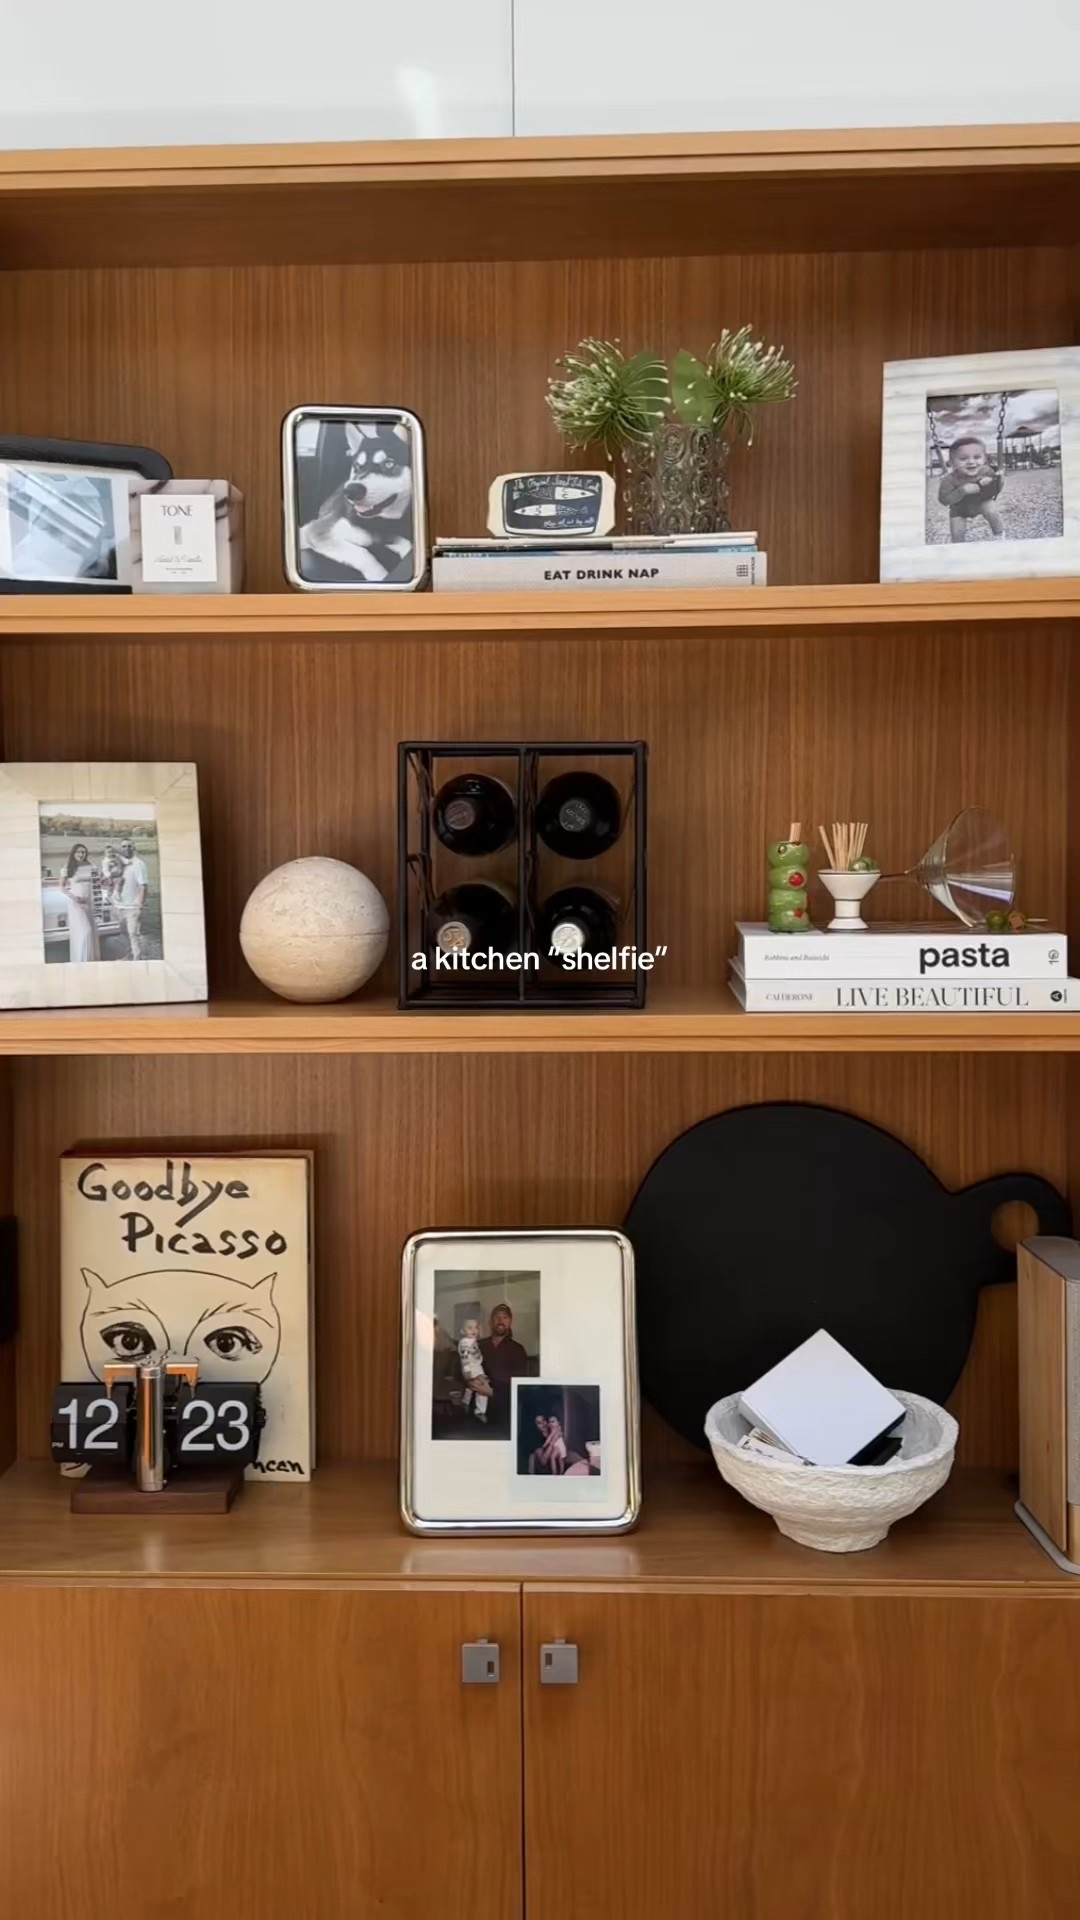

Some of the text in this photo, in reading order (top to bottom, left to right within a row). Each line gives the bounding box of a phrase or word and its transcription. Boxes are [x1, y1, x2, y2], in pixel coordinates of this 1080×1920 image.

[160, 504, 193, 517] TONE
[544, 568, 660, 581] EAT DRINK NAP
[919, 942, 1011, 975] pasta
[836, 986, 1029, 1008] LIVE BEAUTIFUL
[77, 1160, 250, 1228] Goodbye
[119, 1212, 288, 1260] Picasso
[58, 1398, 119, 1450] 12
[181, 1400, 250, 1451] 23
[252, 1459, 305, 1475] ncan
